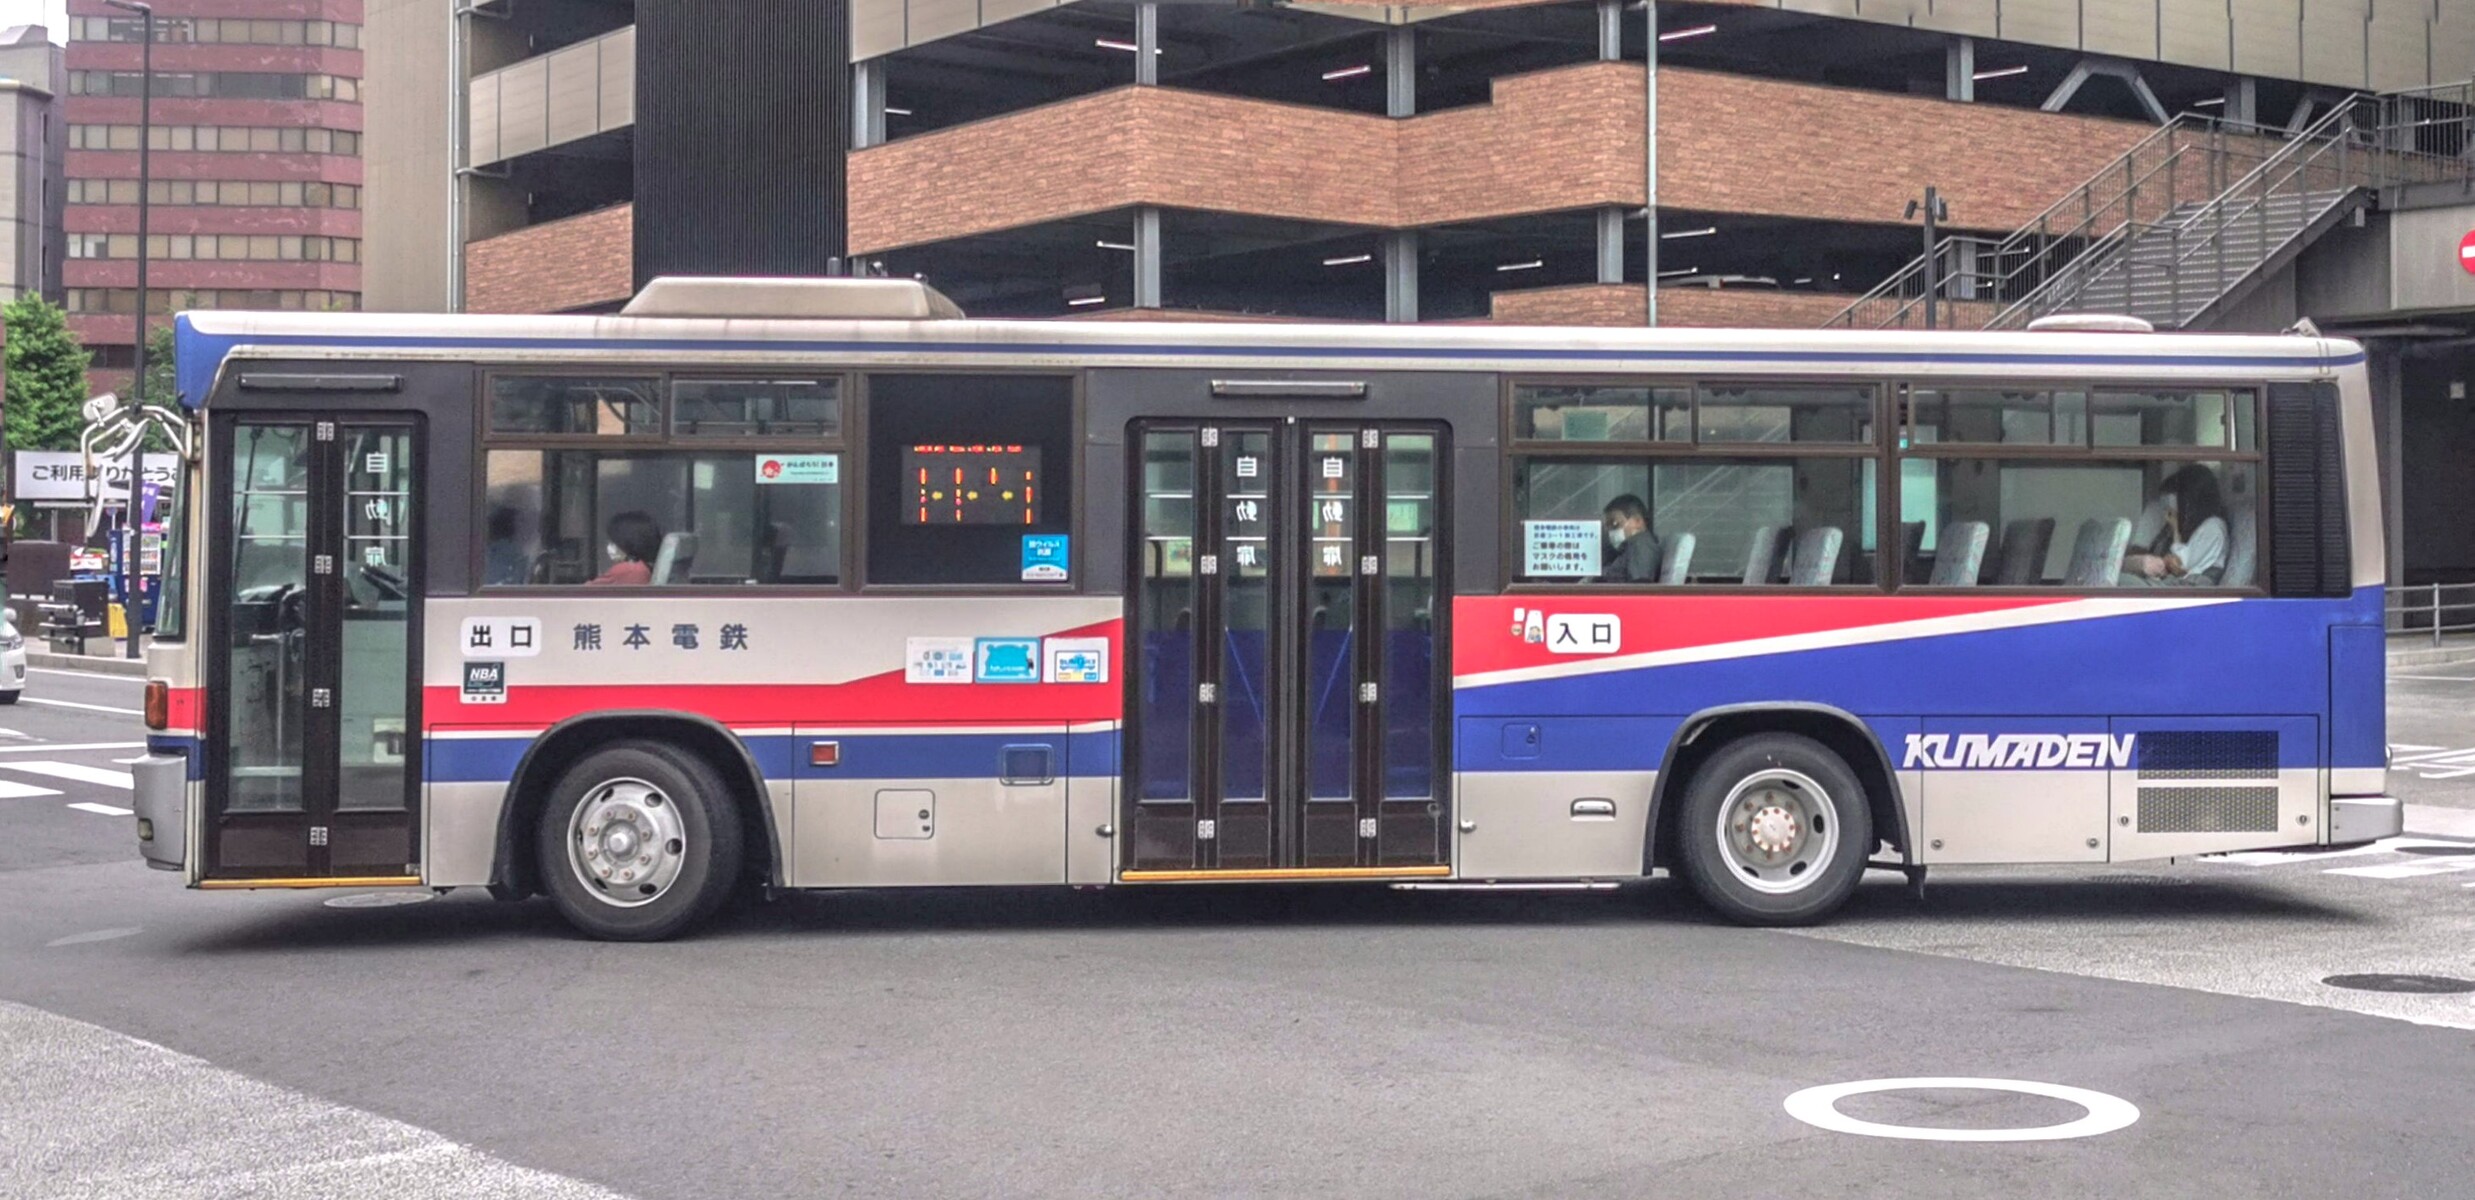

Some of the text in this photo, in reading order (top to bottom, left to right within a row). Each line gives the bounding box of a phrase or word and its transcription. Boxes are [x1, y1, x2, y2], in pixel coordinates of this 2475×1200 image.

[470, 624, 532, 648] 出口
[573, 623, 748, 650] 熊本電鉄
[1556, 622, 1611, 645] 入口
[470, 667, 498, 681] NBA
[1902, 733, 2135, 768] KUMADEN
